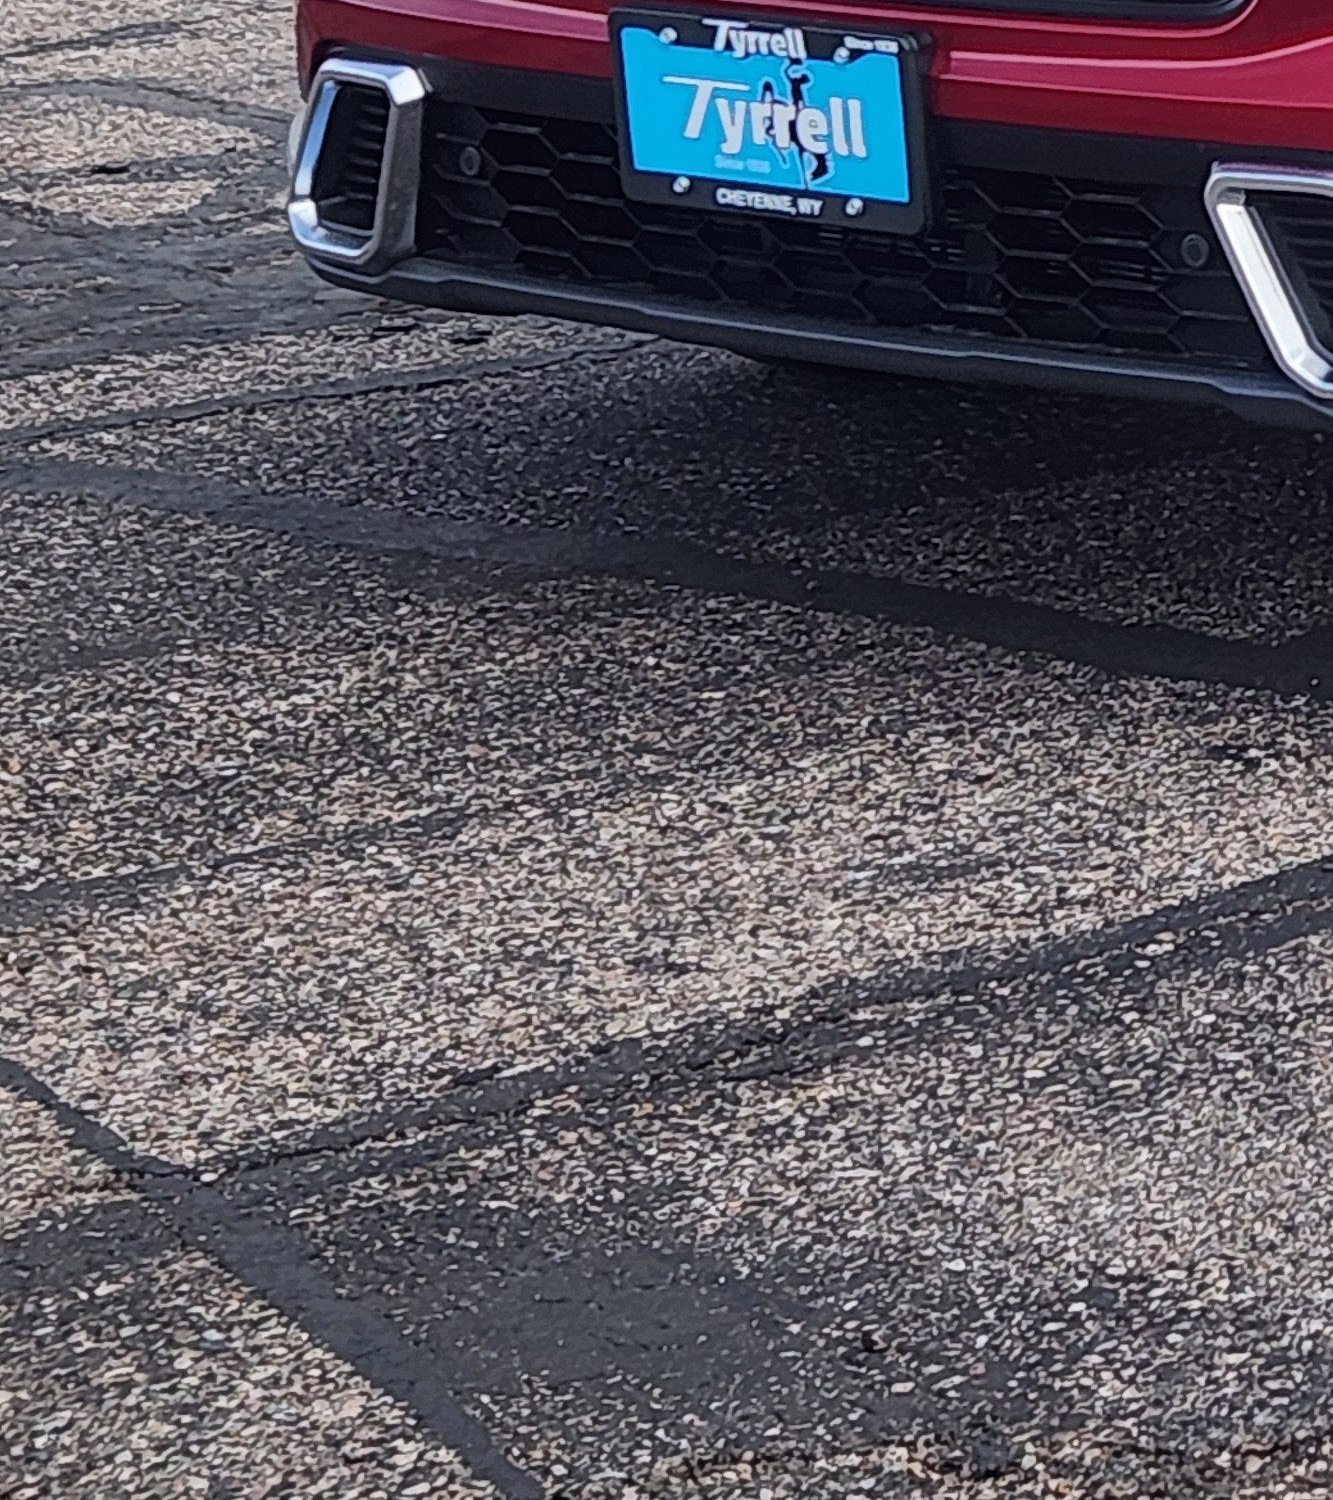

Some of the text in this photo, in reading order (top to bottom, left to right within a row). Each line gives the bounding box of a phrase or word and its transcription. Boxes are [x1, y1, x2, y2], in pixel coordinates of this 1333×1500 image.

[702, 17, 808, 60] Tyrrell
[661, 75, 868, 159] Tyrrell
[797, 197, 824, 217] WY
